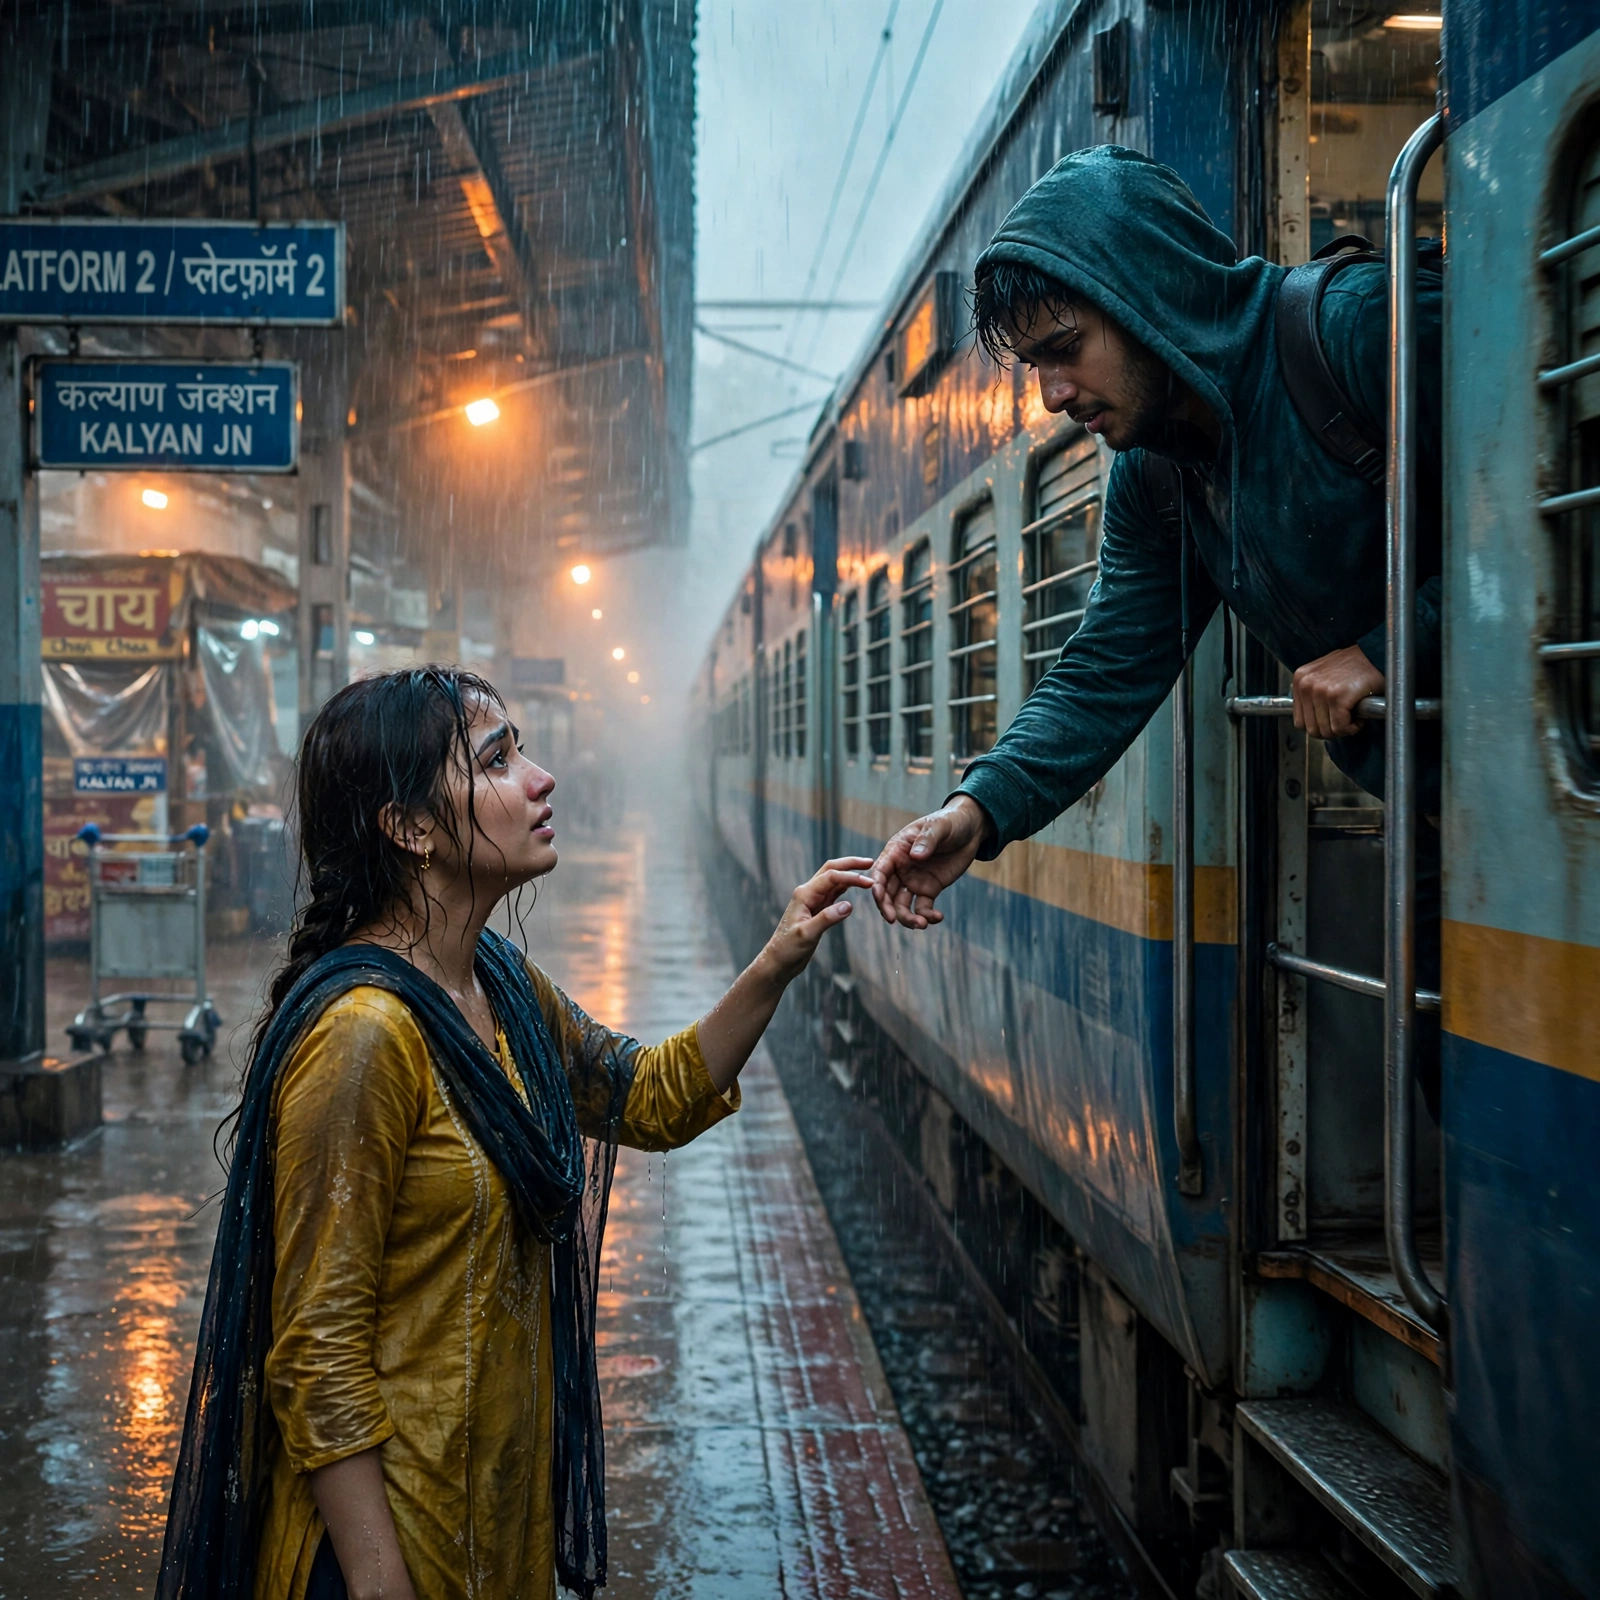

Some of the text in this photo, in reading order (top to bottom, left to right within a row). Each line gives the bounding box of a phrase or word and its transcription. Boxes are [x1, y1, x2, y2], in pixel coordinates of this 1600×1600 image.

[0, 250, 125, 293] ATFORM
[135, 249, 155, 293] 2
[164, 250, 175, 296] /
[305, 254, 325, 297] 2
[56, 373, 279, 414] कल्याण जंक्शन
[80, 422, 252, 456] KALYAN JN
[56, 588, 160, 631] चाय
